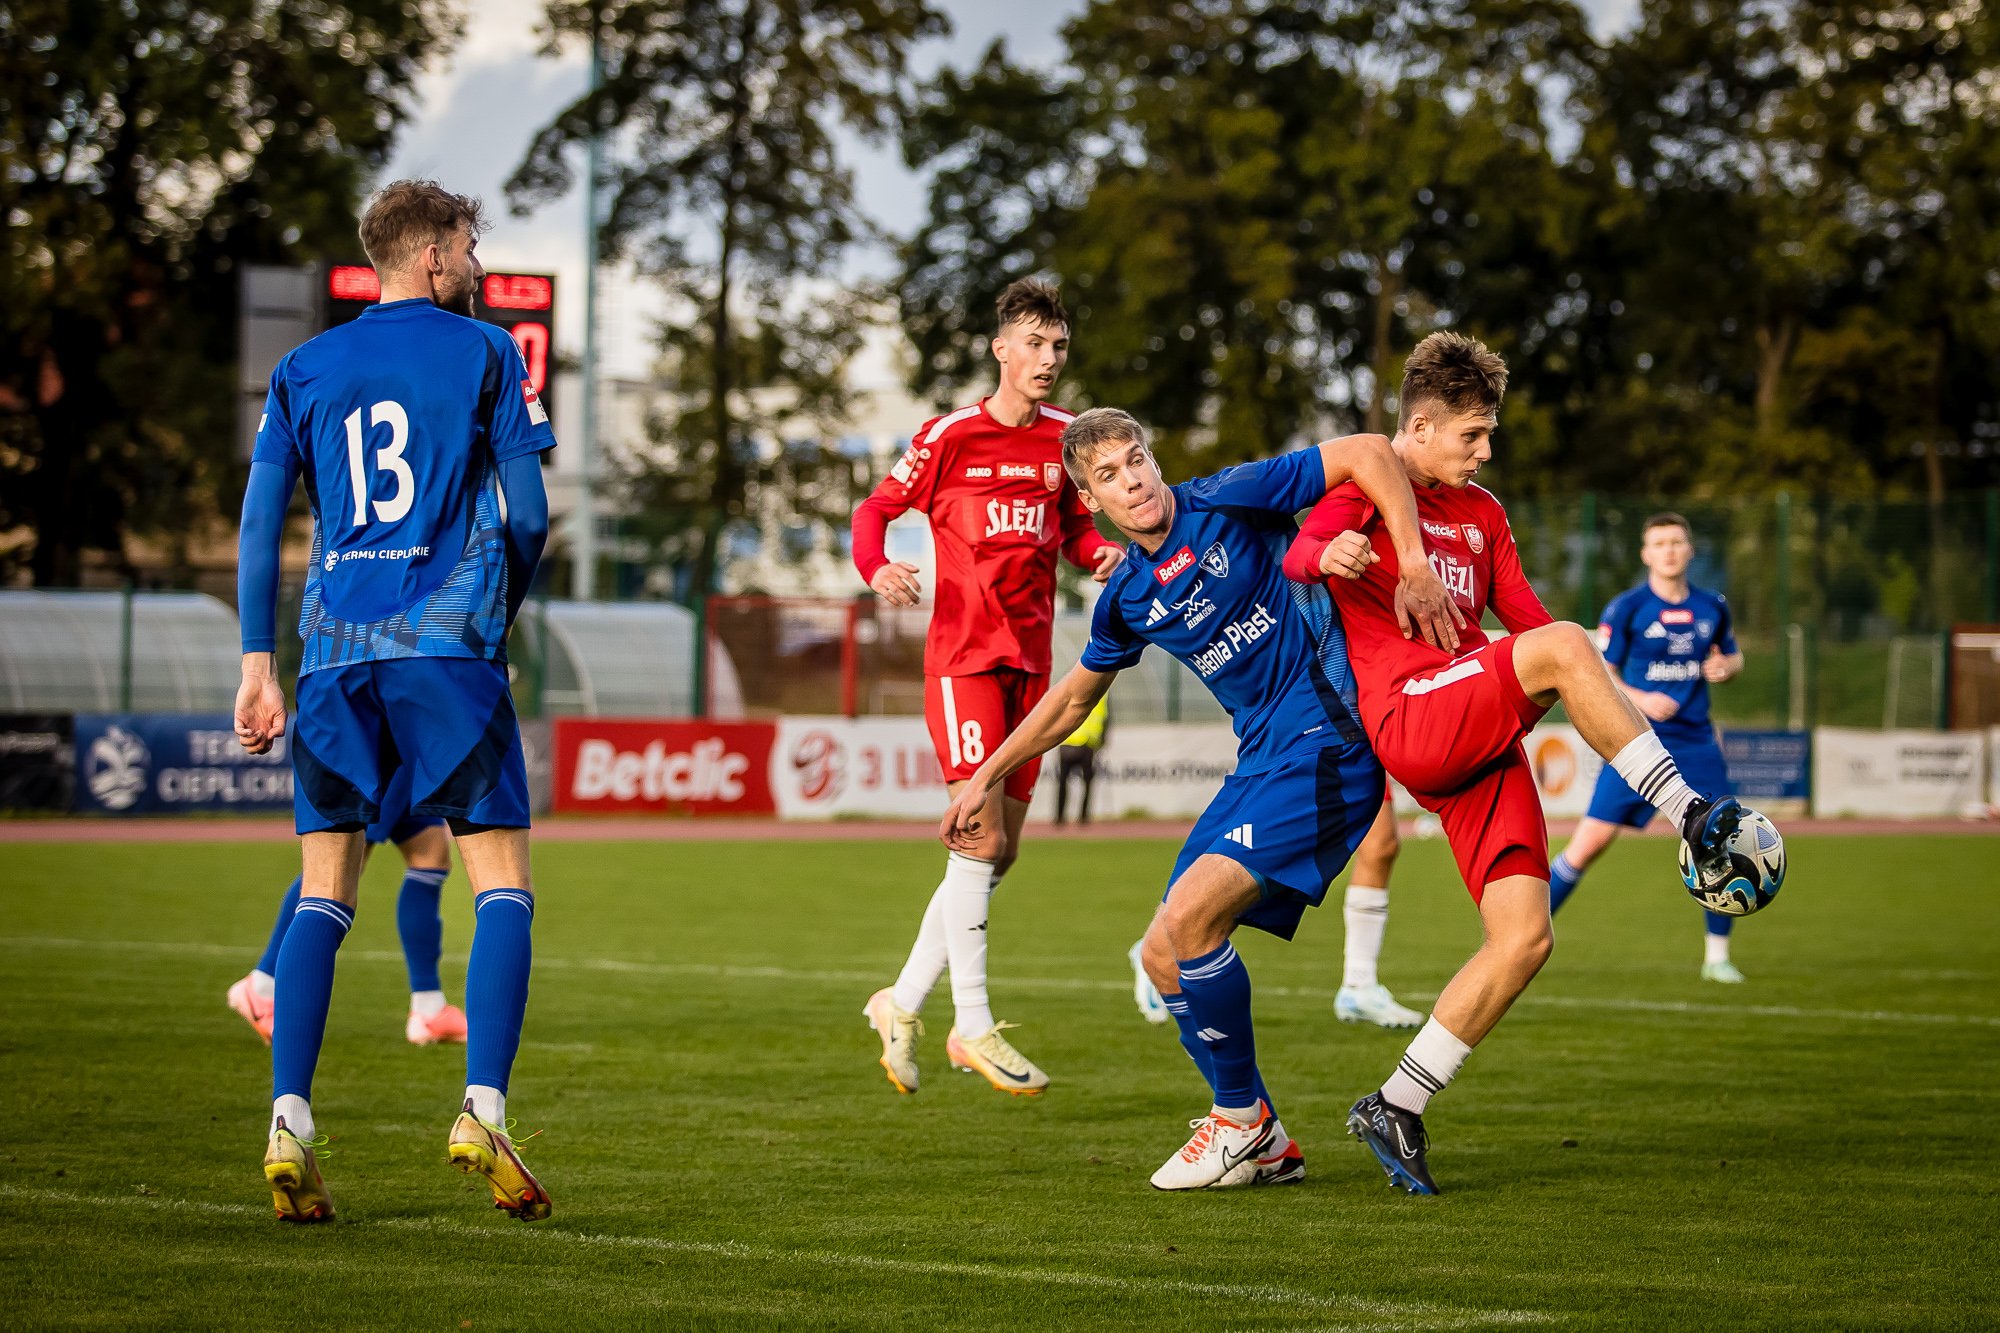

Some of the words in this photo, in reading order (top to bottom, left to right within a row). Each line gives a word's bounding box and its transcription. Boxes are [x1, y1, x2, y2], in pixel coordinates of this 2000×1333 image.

[344, 400, 415, 527] 13
[965, 467, 993, 478] JAKO
[1000, 464, 1036, 478] Betclic
[1423, 522, 1457, 539] Betclic
[341, 550, 376, 562] TERMY
[1158, 552, 1192, 582] Betclic
[1223, 603, 1278, 653] Plast
[961, 719, 985, 765] 8
[572, 737, 750, 801] Betclic
